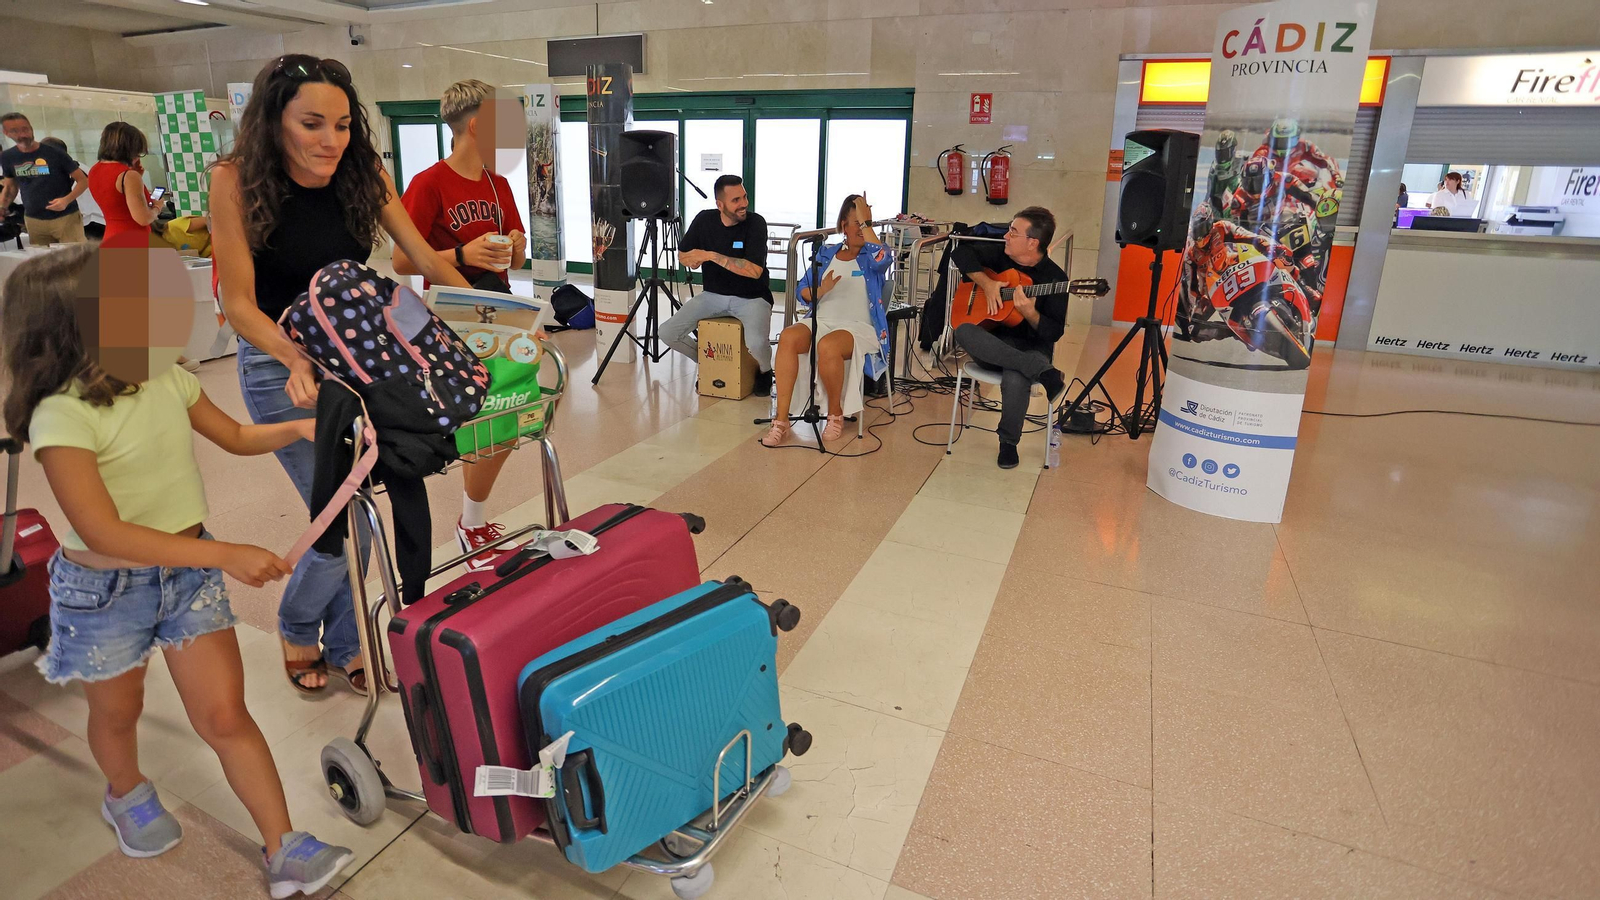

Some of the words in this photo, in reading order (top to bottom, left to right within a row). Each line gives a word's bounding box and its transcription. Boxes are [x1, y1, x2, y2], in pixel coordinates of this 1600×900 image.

[1222, 18, 1358, 59] CÁDIZ
[1231, 60, 1328, 77] PROVINCIA
[1510, 65, 1600, 101] Firefl
[1288, 228, 1305, 250] 6
[1222, 266, 1256, 302] 93
[716, 343, 733, 356] NINA
[1375, 336, 1407, 347] Hertz
[1416, 340, 1450, 351] Hertz
[1459, 343, 1495, 355] Hertz
[1504, 348, 1541, 359] Hertz
[1550, 352, 1588, 364] Hertz
[480, 391, 531, 411] Binter
[1200, 404, 1233, 416] Diputación
[1208, 413, 1226, 424] Cádiz
[1174, 421, 1261, 445] www.cadizturismo.com
[1168, 467, 1248, 496] @CadizTurismo
